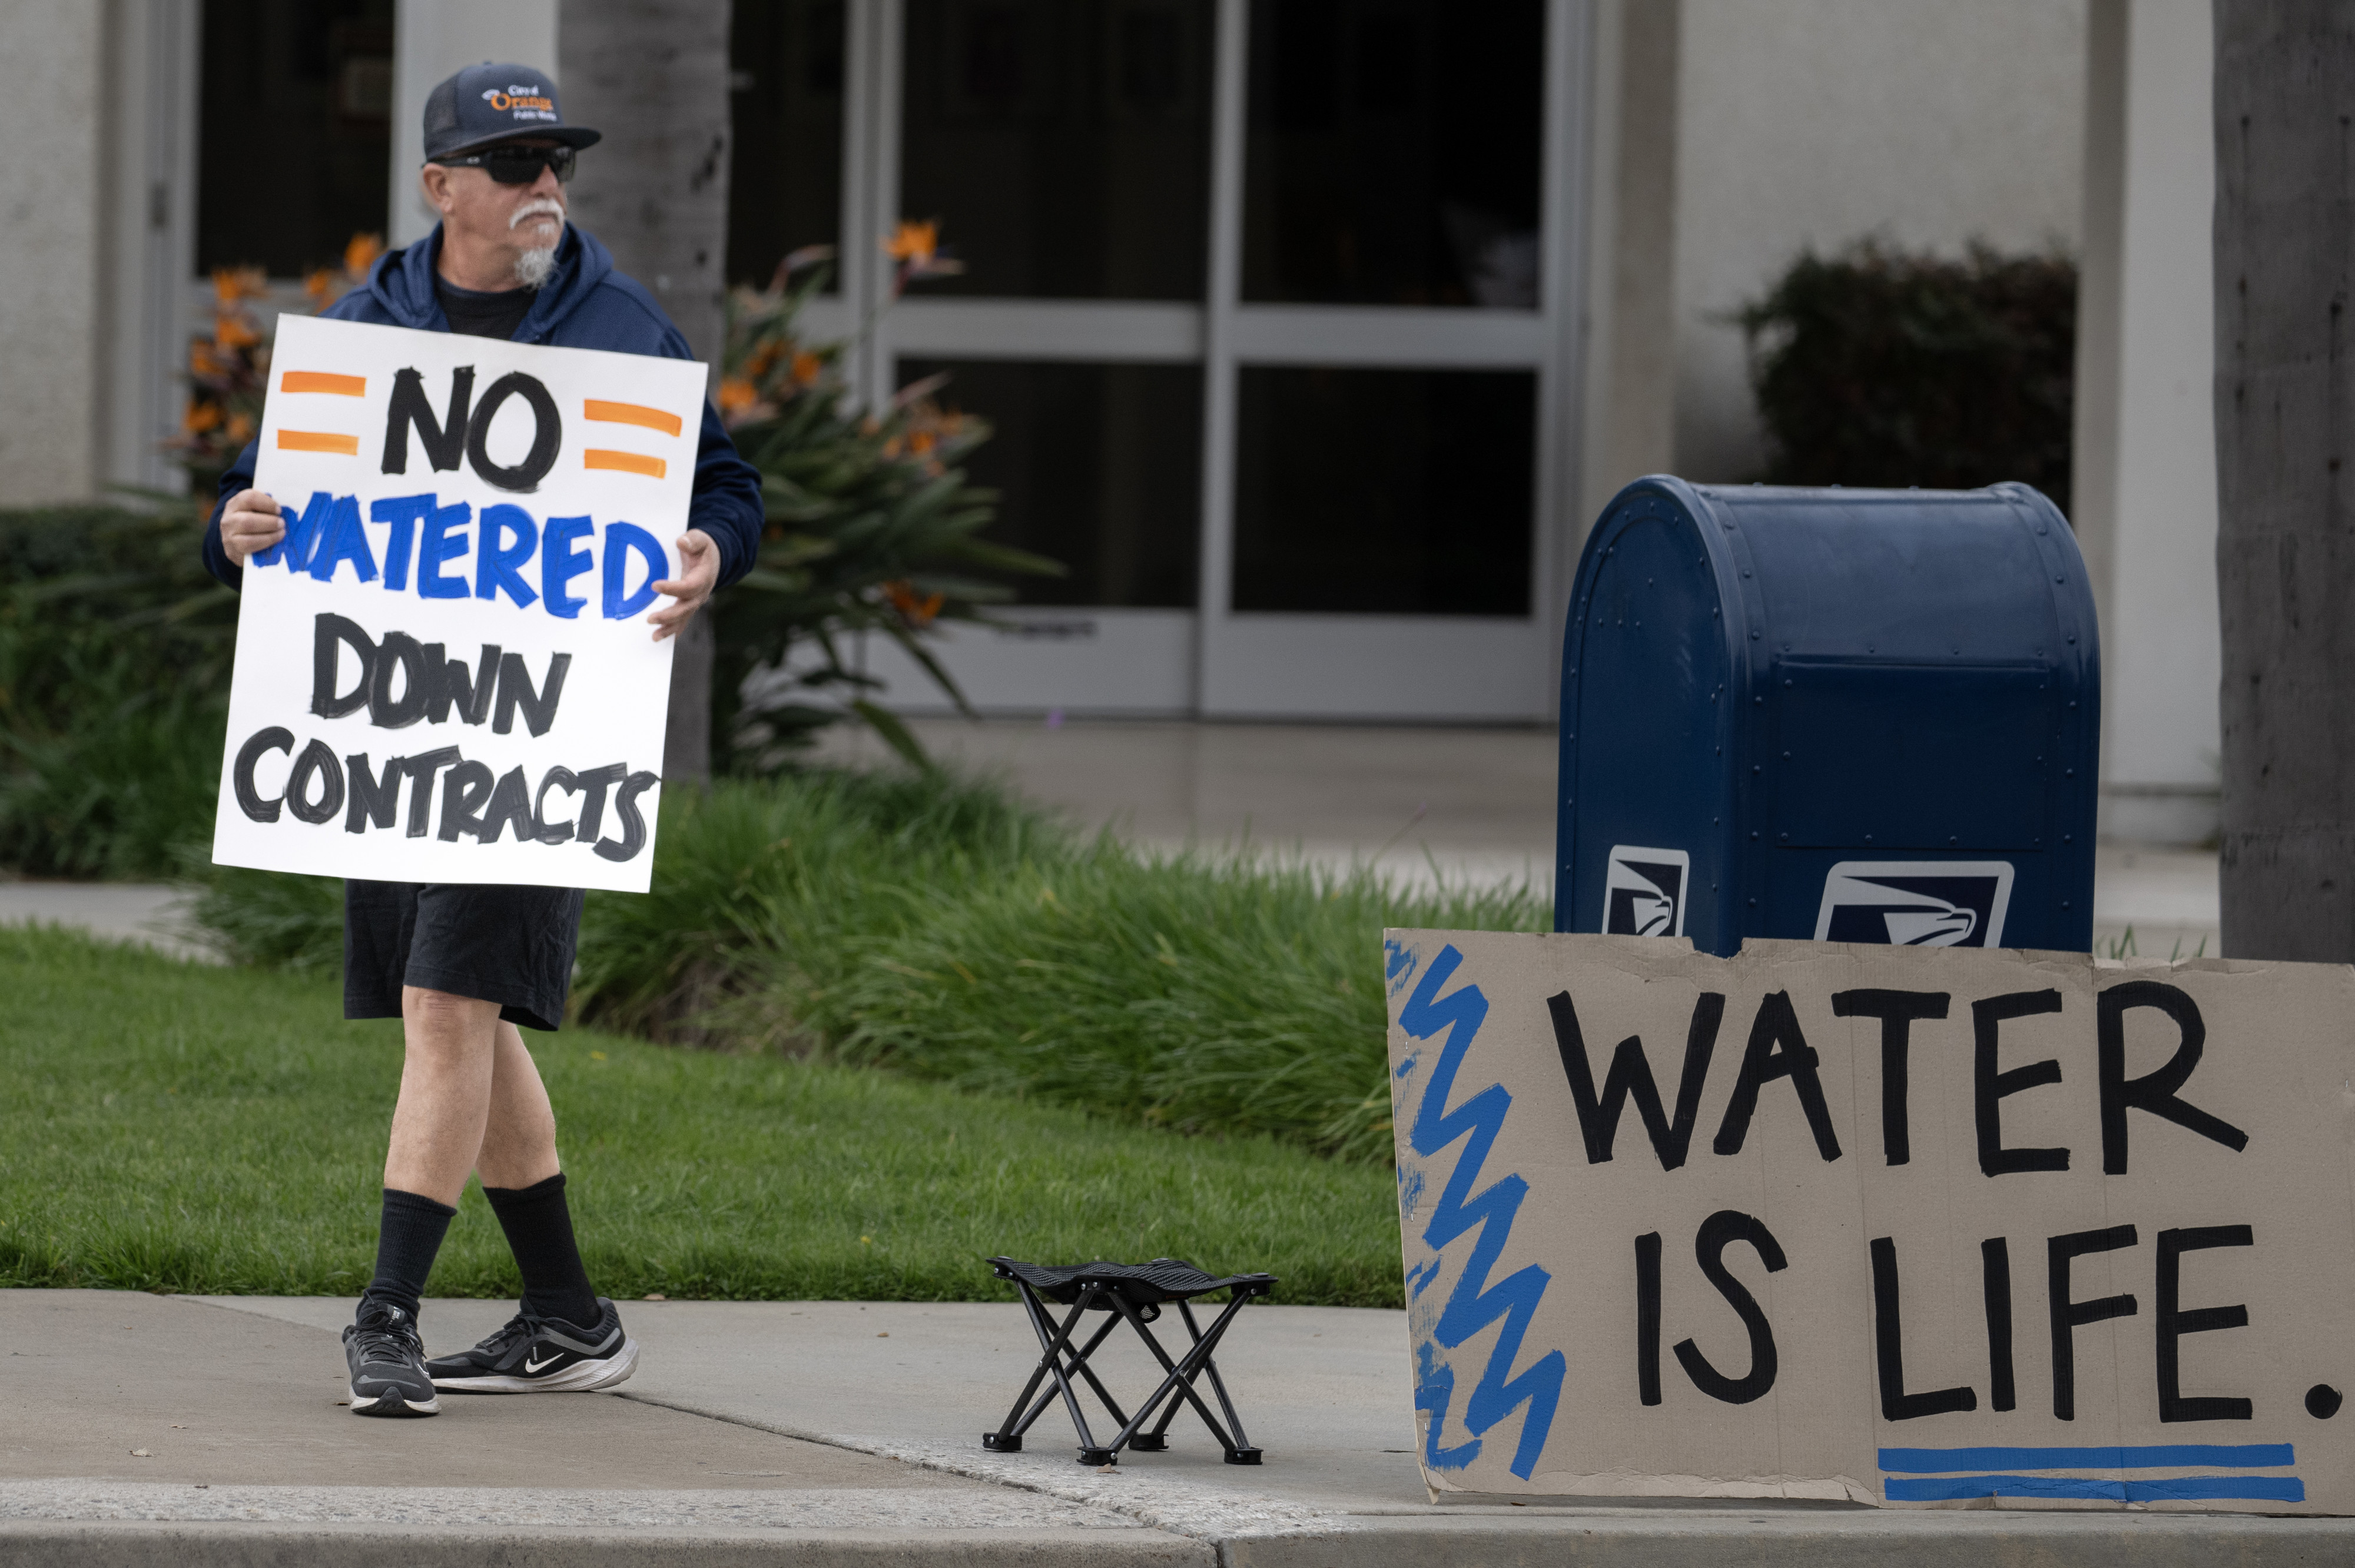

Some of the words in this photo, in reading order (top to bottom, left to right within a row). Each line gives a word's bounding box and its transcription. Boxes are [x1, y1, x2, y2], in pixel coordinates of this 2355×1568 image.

[380, 364, 562, 494] NO
[252, 491, 669, 620] WATERED
[309, 612, 572, 738] DOWN
[233, 726, 661, 863] CONTRACTS
[1545, 979, 2250, 1178] WATER
[1634, 1210, 1789, 1407] IS
